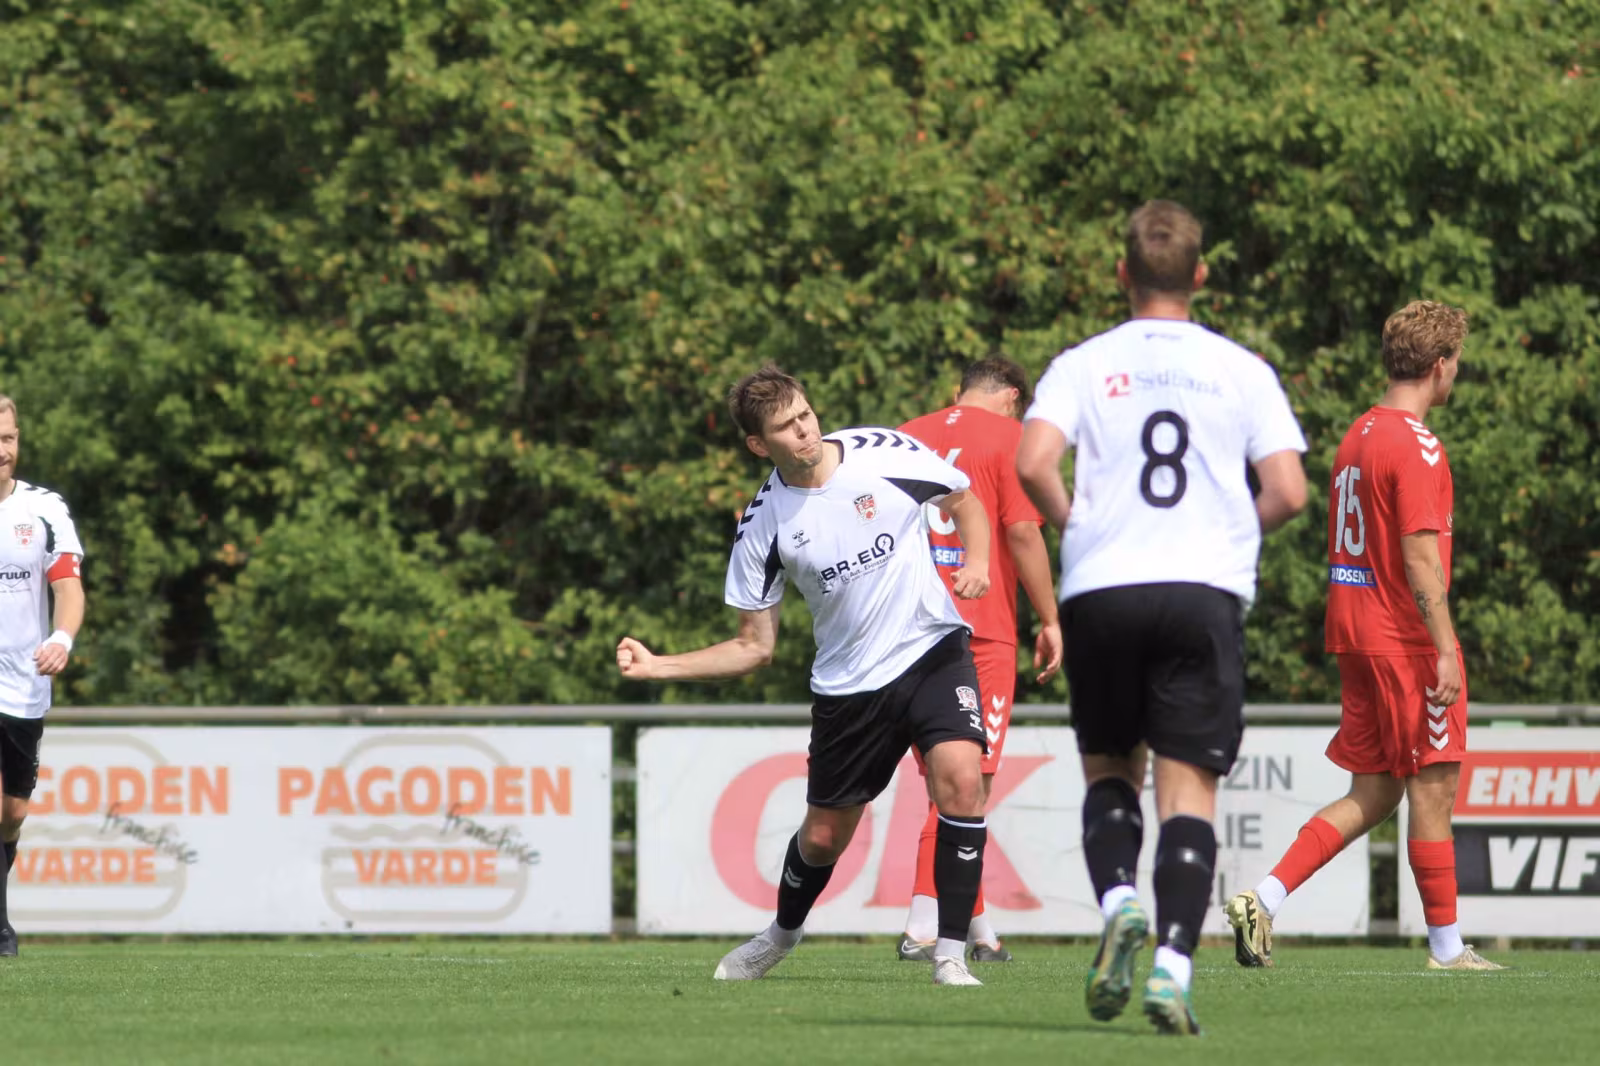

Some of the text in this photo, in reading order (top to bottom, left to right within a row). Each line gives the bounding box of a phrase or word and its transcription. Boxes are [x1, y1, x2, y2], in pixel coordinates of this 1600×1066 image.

[1140, 410, 1189, 508] 8
[1335, 465, 1365, 556] 15
[27, 766, 229, 816] GODEN
[277, 766, 572, 816] PAGODEN
[709, 752, 1056, 911] OK
[15, 848, 157, 884] VARDE
[352, 848, 498, 885] VARDE
